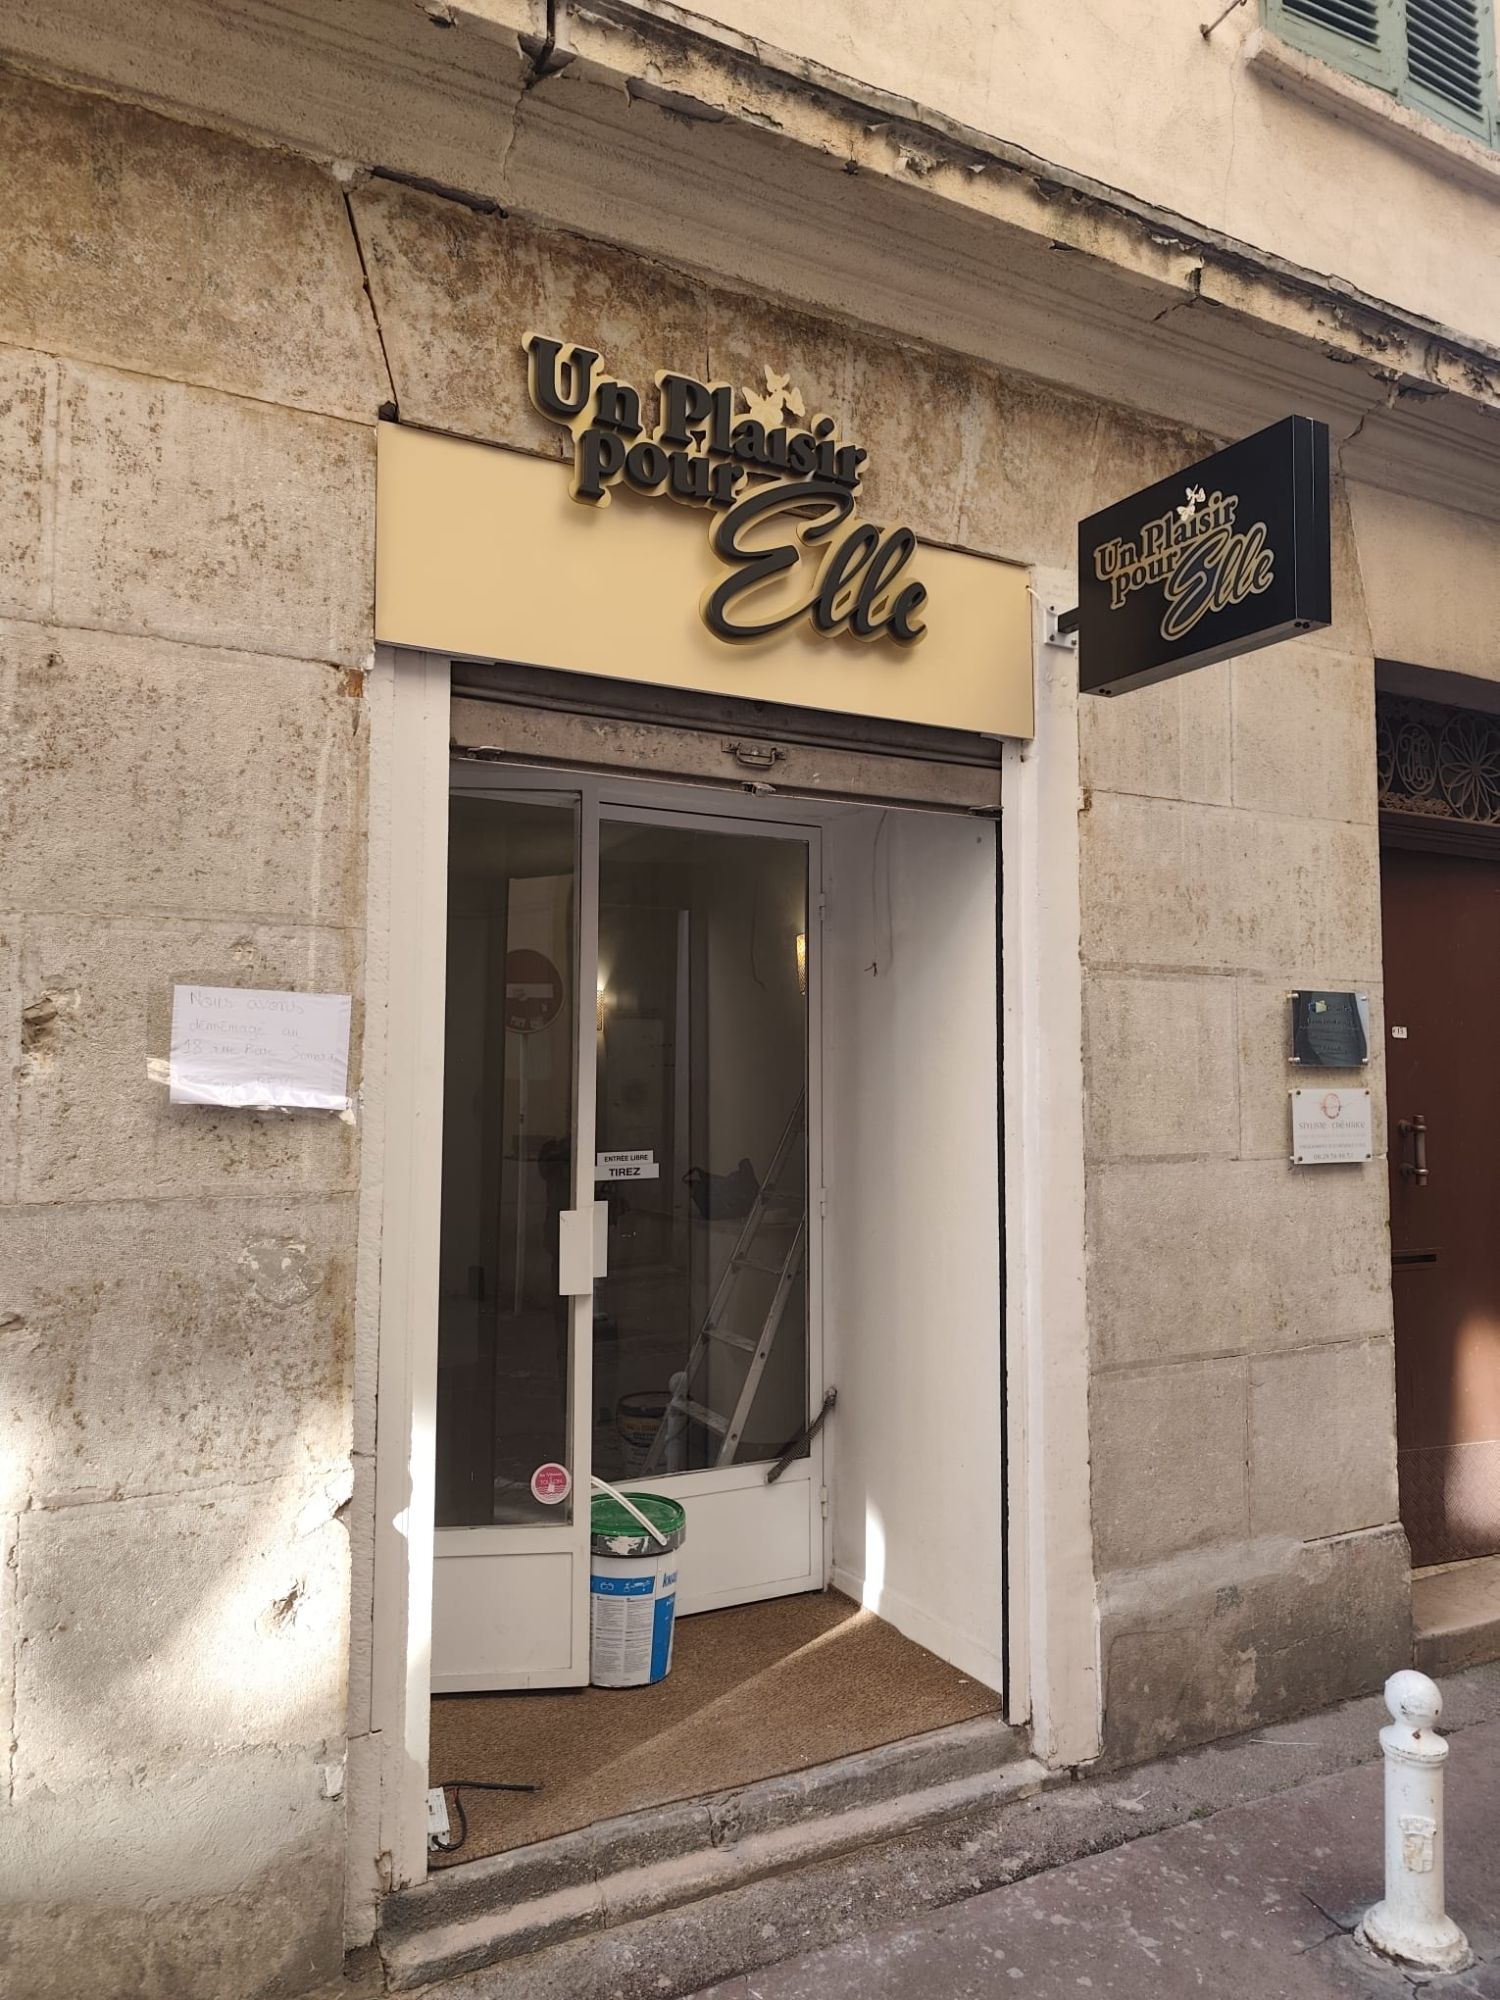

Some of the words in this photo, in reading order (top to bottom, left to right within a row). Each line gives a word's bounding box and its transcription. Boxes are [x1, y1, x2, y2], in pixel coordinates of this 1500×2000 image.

[527, 334, 644, 438] Un
[658, 373, 869, 489] Plaisir
[574, 428, 747, 506] pour
[703, 480, 929, 643] Elle
[1095, 538, 1137, 579] Un
[1141, 492, 1238, 559] Plaisir
[1111, 549, 1179, 609] pour
[1160, 522, 1274, 641] Elle
[190, 991, 233, 1009] Nous
[246, 998, 305, 1015] avons
[604, 1155, 629, 1163] ENTRÉE
[608, 1167, 641, 1177] TIREZ
